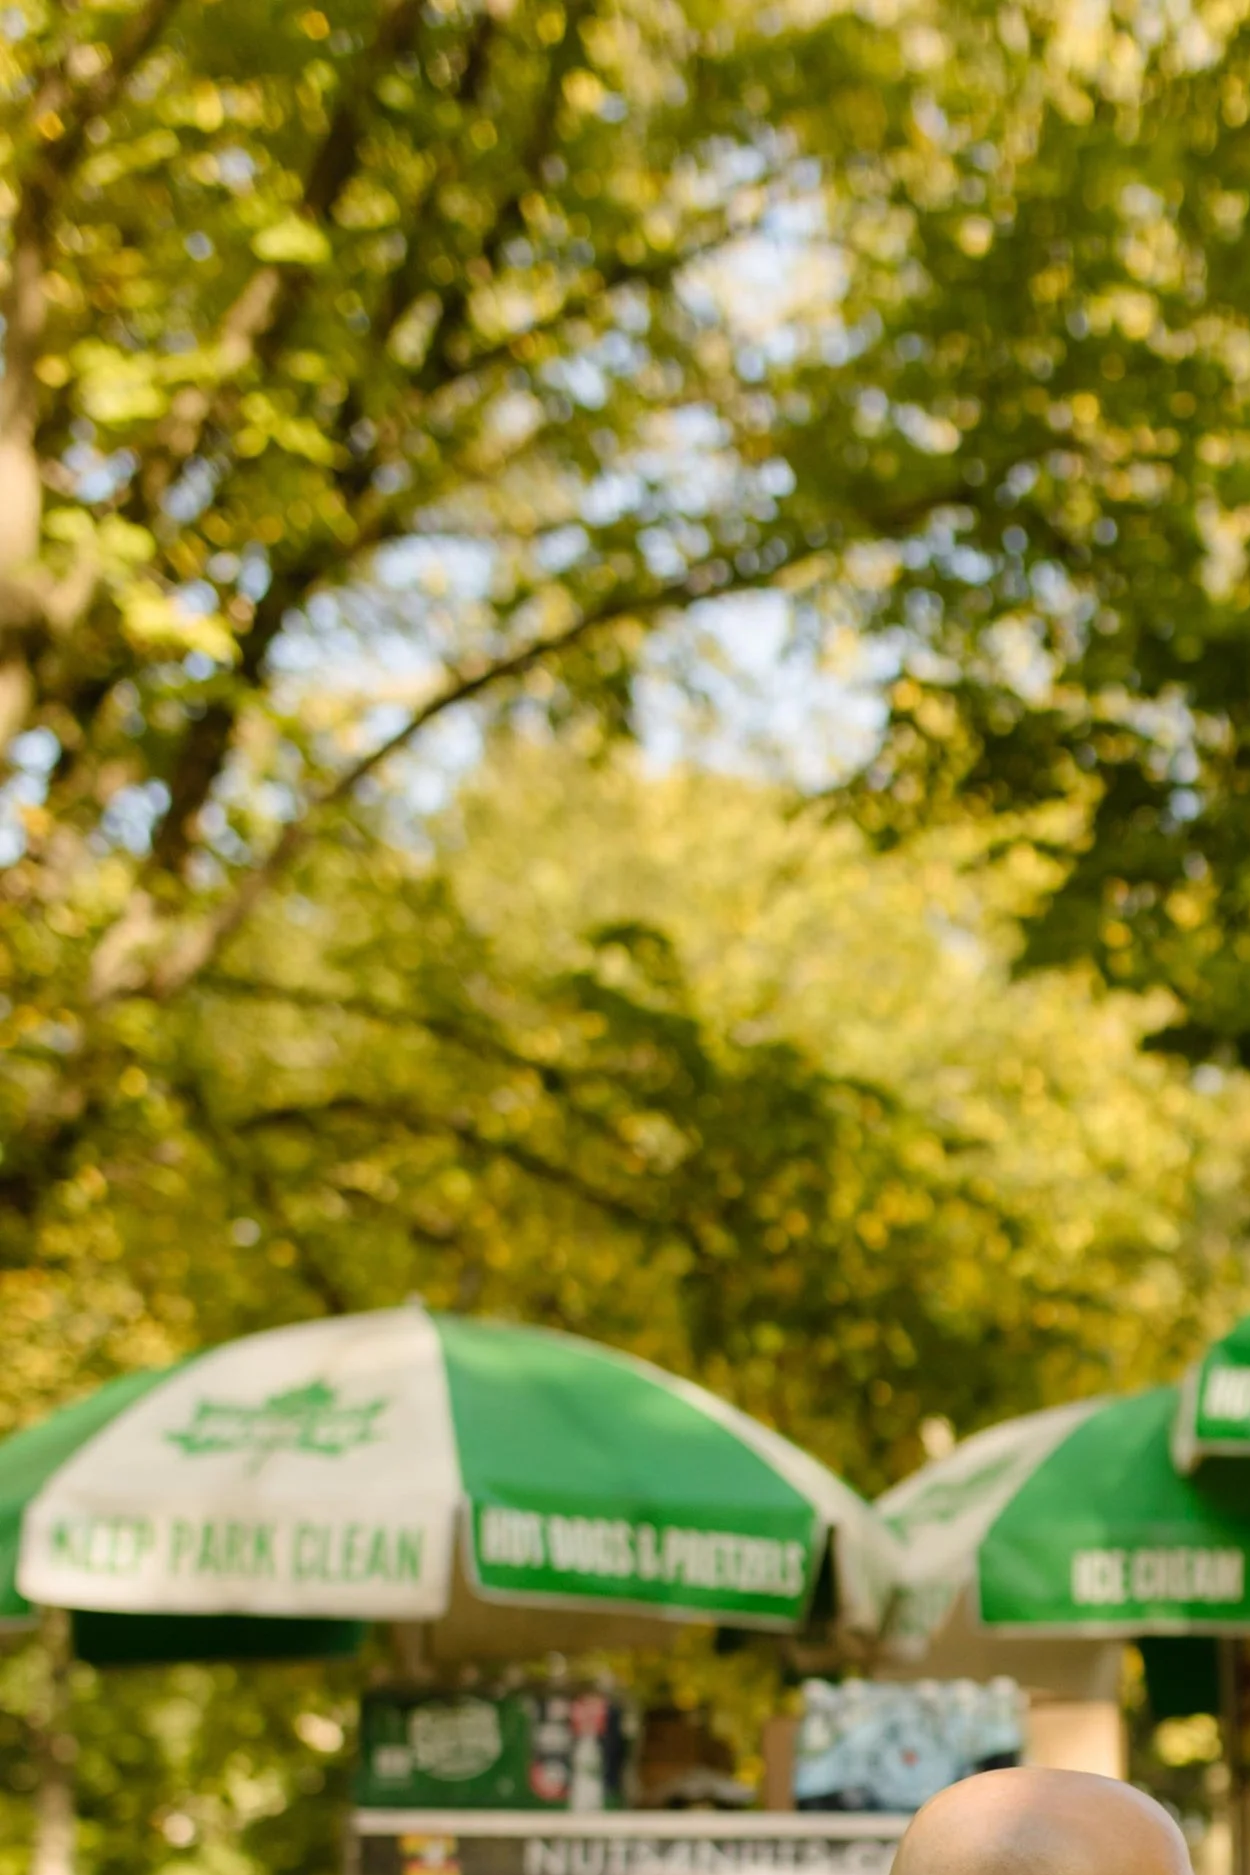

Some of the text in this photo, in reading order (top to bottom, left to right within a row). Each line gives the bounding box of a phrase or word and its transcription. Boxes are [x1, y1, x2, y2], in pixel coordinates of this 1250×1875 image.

[48, 1513, 424, 1583] KEEP PARK CLEAN
